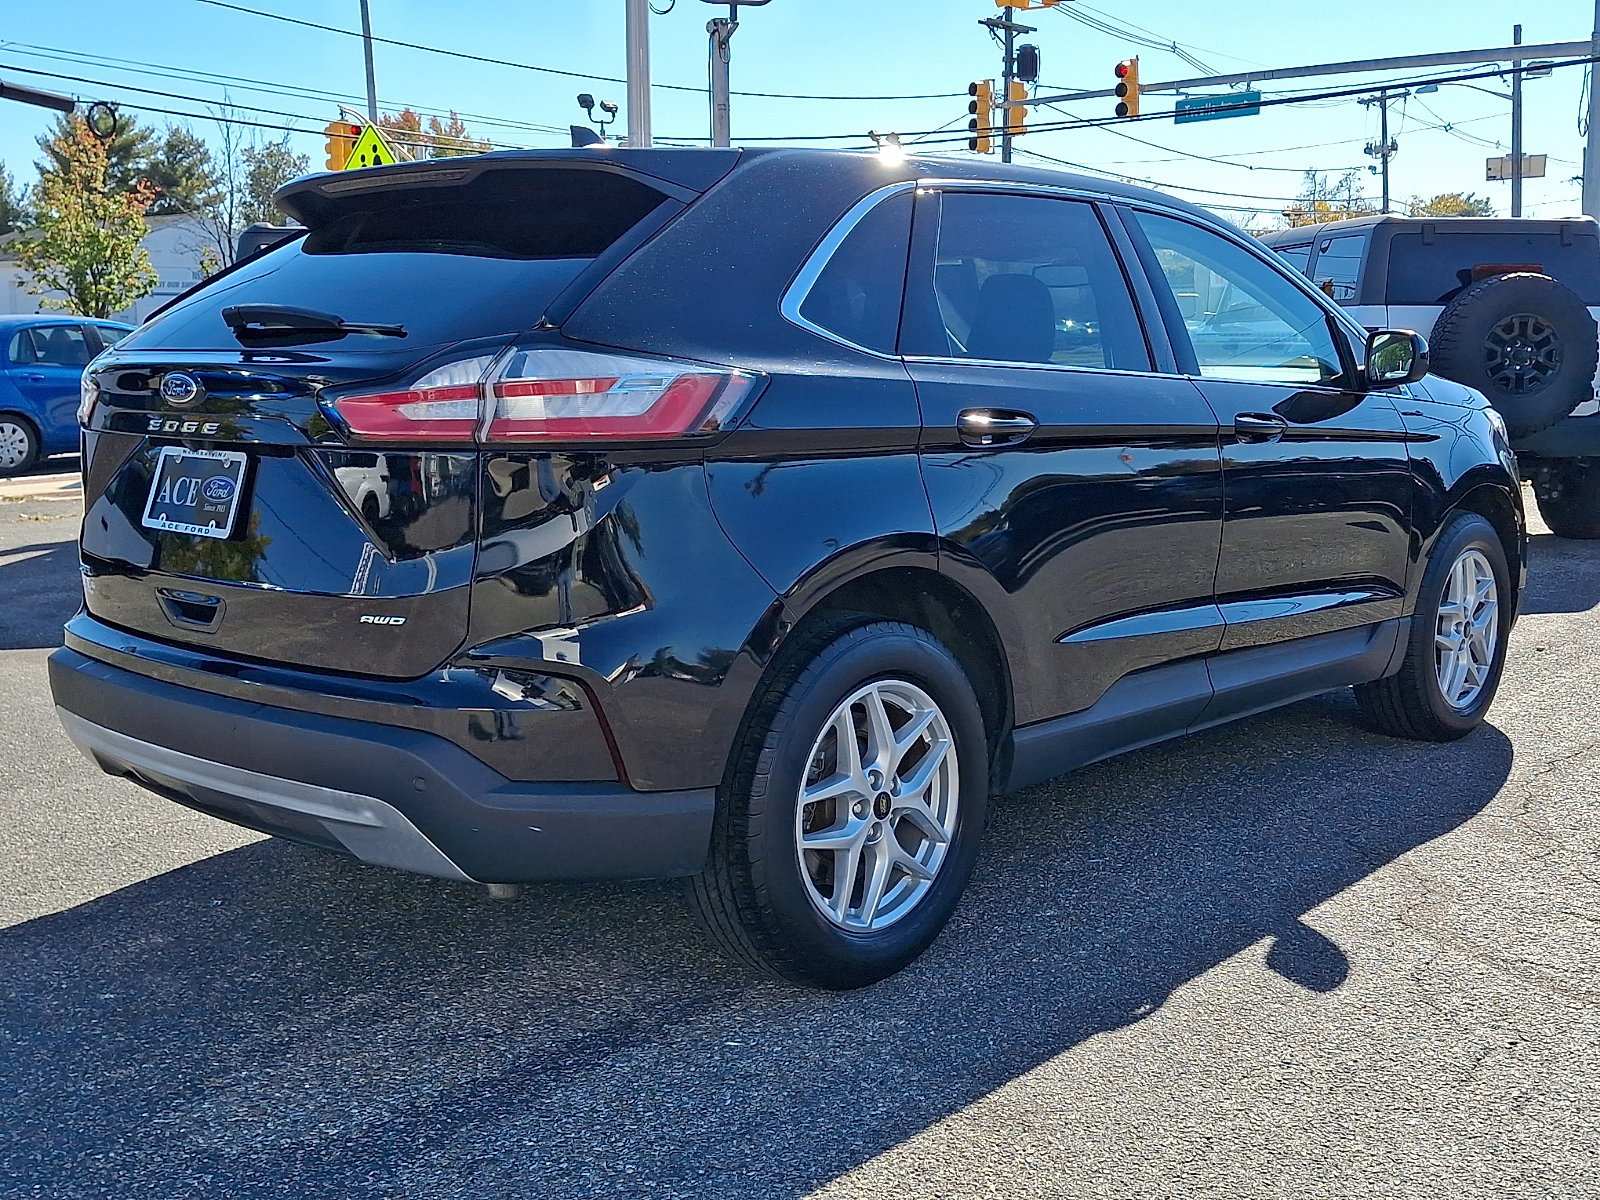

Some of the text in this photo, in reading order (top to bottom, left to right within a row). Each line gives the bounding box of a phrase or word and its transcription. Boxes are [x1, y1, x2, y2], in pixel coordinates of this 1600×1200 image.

[164, 380, 186, 396] Ford
[147, 419, 220, 435] EDGE
[156, 476, 231, 507] ACE Ford
[161, 522, 210, 535] ACE FORD
[359, 615, 407, 625] AWD
